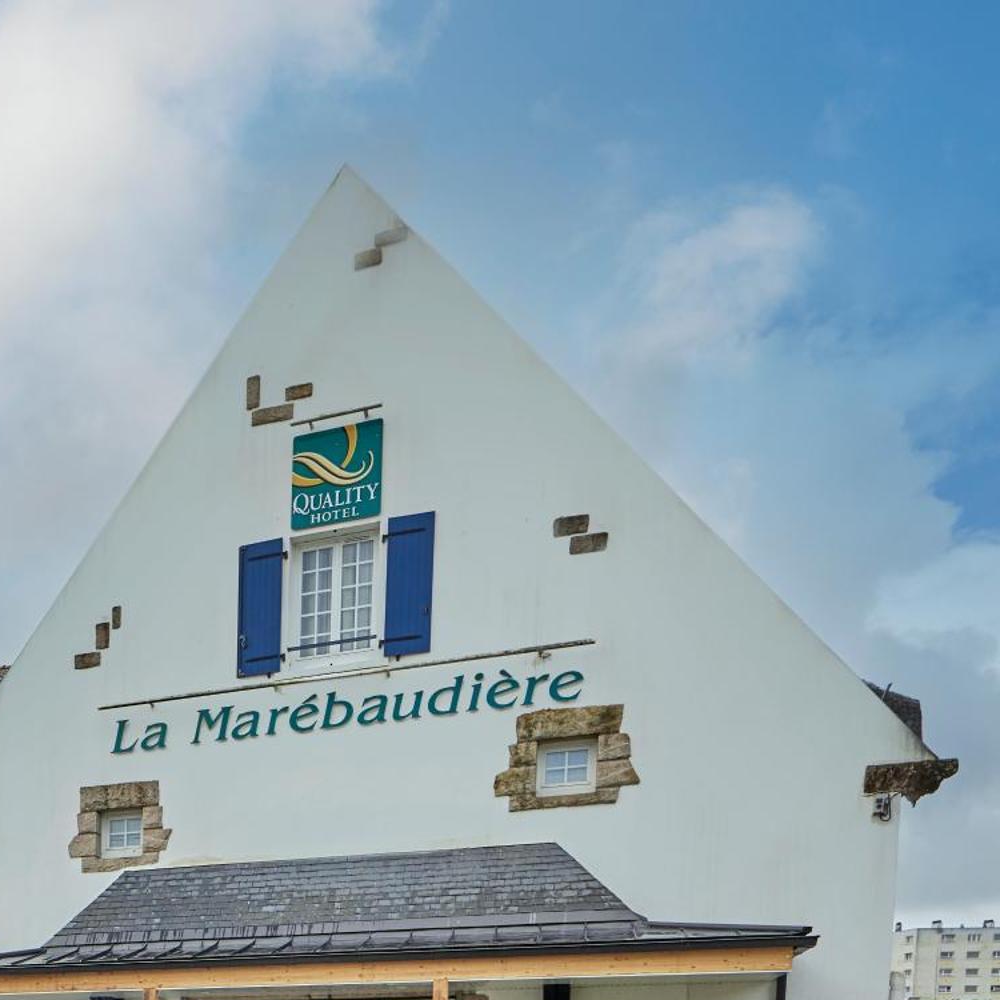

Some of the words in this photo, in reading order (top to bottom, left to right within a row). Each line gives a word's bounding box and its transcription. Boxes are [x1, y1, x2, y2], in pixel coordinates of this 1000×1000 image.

[293, 483, 379, 515] QUALITY
[311, 506, 360, 524] HOTEL
[111, 720, 168, 754] La
[191, 669, 585, 745] Marébaudière
